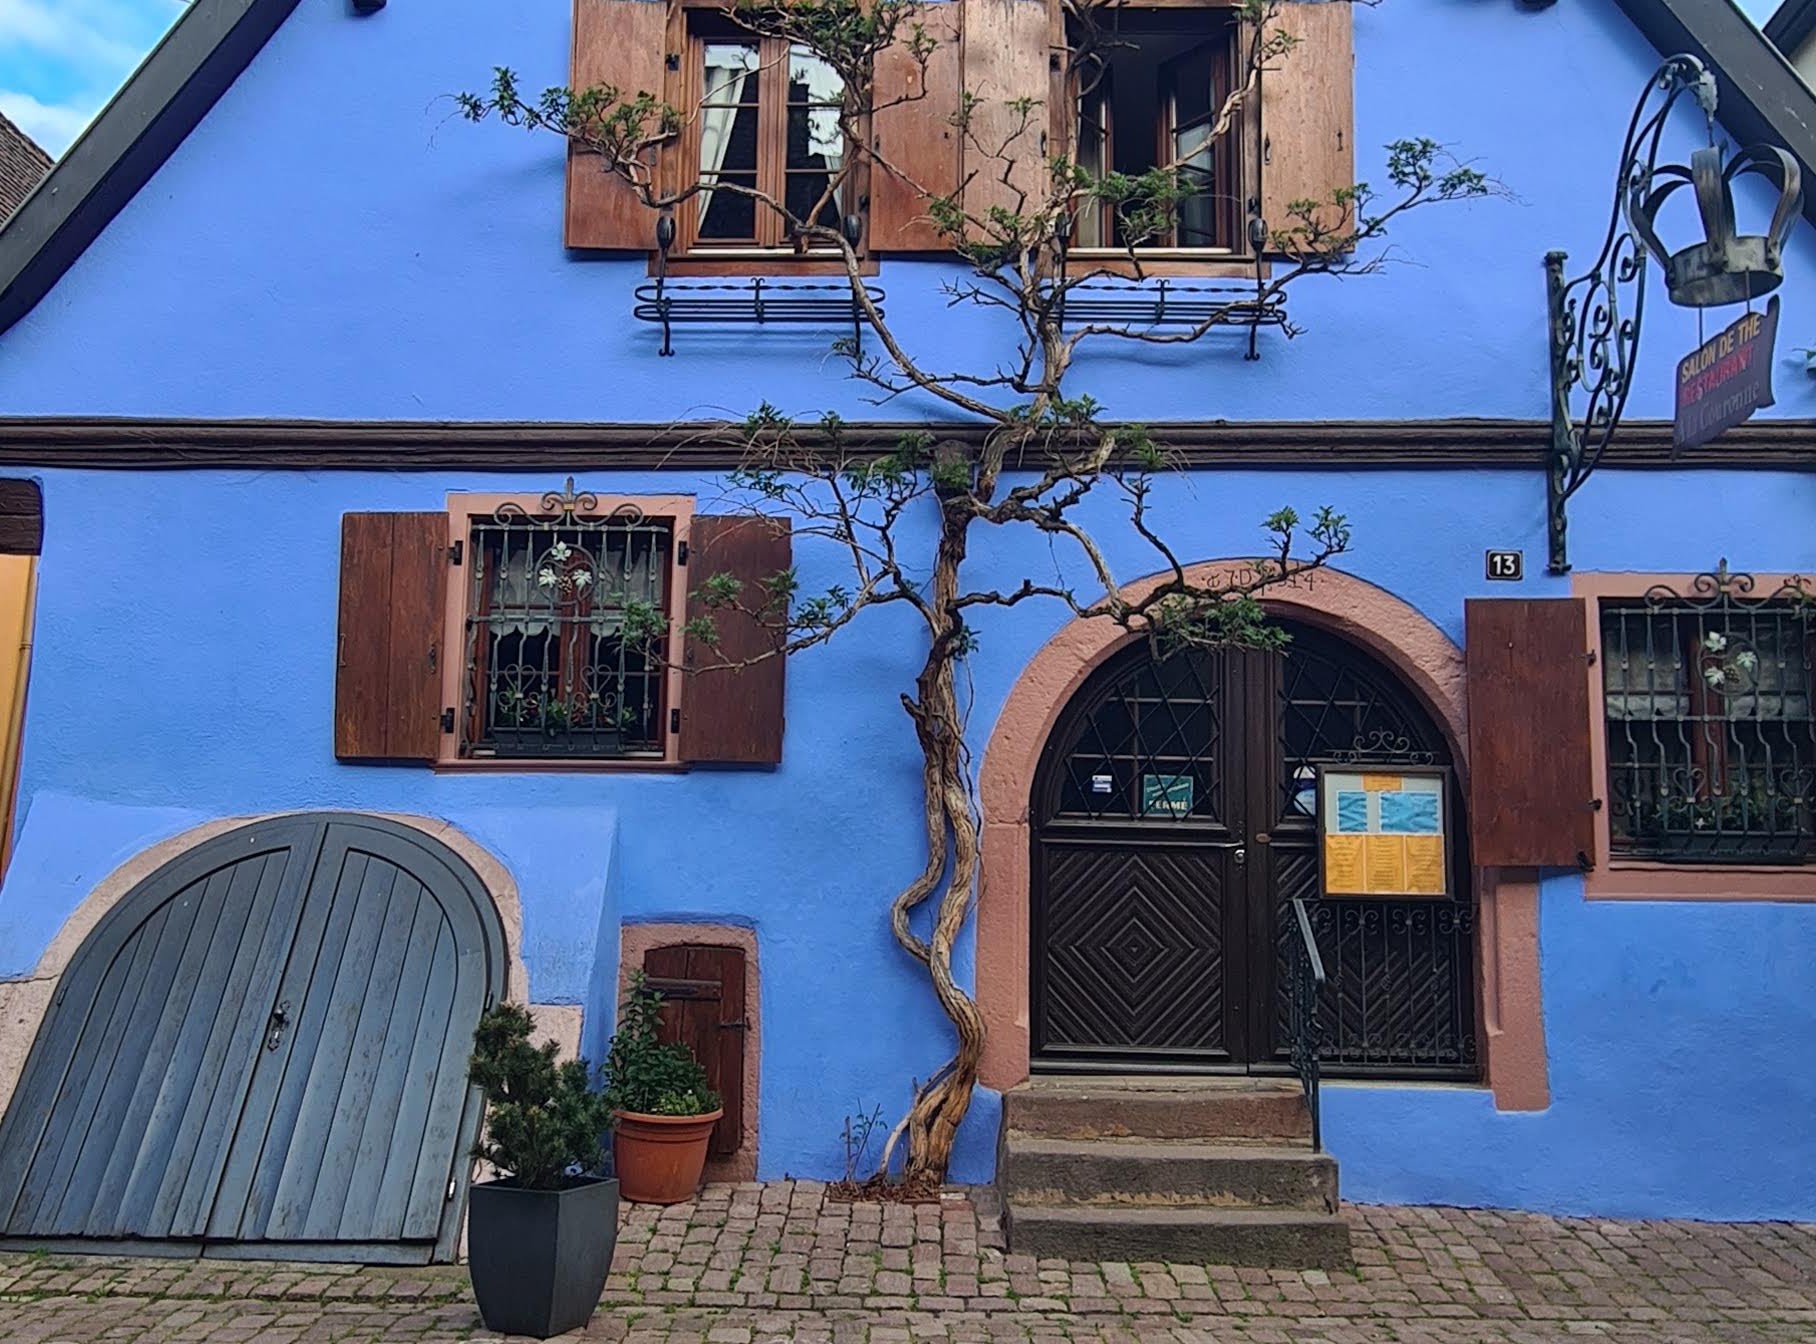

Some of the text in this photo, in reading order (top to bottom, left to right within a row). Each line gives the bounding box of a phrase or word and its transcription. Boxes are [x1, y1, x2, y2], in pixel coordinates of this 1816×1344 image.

[1681, 314, 1761, 384] SALON DE THE
[1681, 344, 1755, 406] RESTAURANT
[1492, 555, 1516, 575] 13
